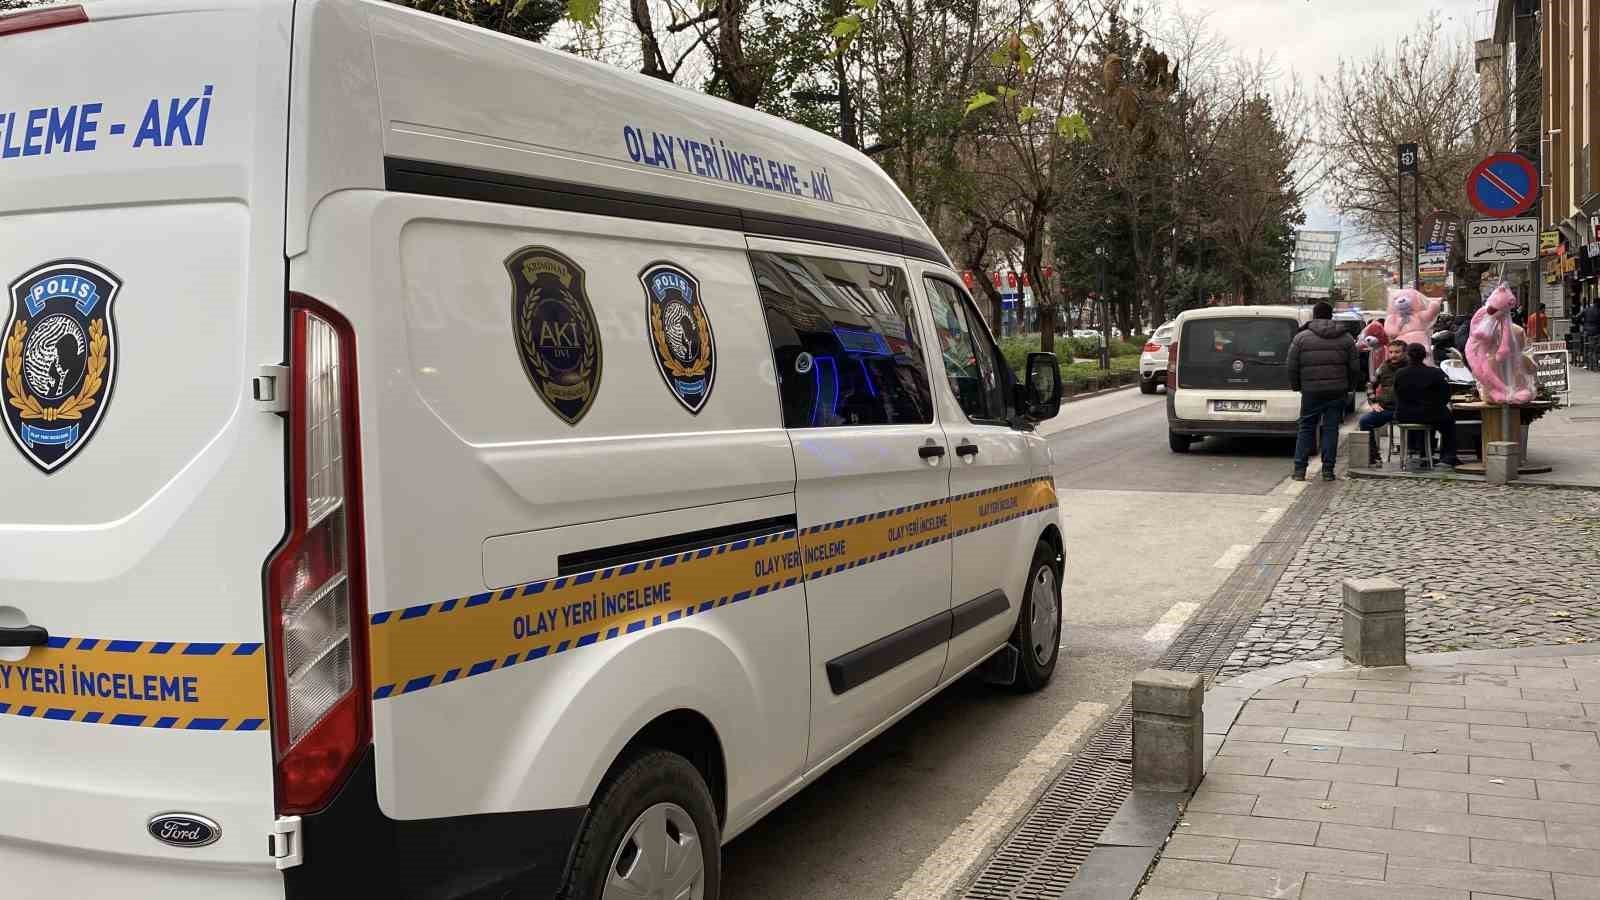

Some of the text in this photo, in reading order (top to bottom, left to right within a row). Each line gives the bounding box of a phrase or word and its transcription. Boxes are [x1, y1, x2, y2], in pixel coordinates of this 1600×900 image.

[0, 102, 103, 159] LEME
[132, 84, 214, 148] AKİ
[623, 125, 677, 170] OLAY
[677, 136, 723, 181] YERİ
[720, 140, 801, 195] İNCELEME
[810, 167, 833, 200] AKİ
[1472, 222, 1535, 235] 20 DAKİKA
[33, 278, 90, 301] POLİS
[539, 318, 578, 348] AKİ
[755, 555, 780, 578] OLAY
[804, 539, 846, 565] İNCELEME
[513, 581, 672, 640] OLAY YERİ İNCELEME
[0, 663, 200, 703] Y YERİ İNCELEME
[160, 820, 201, 841] Ford
